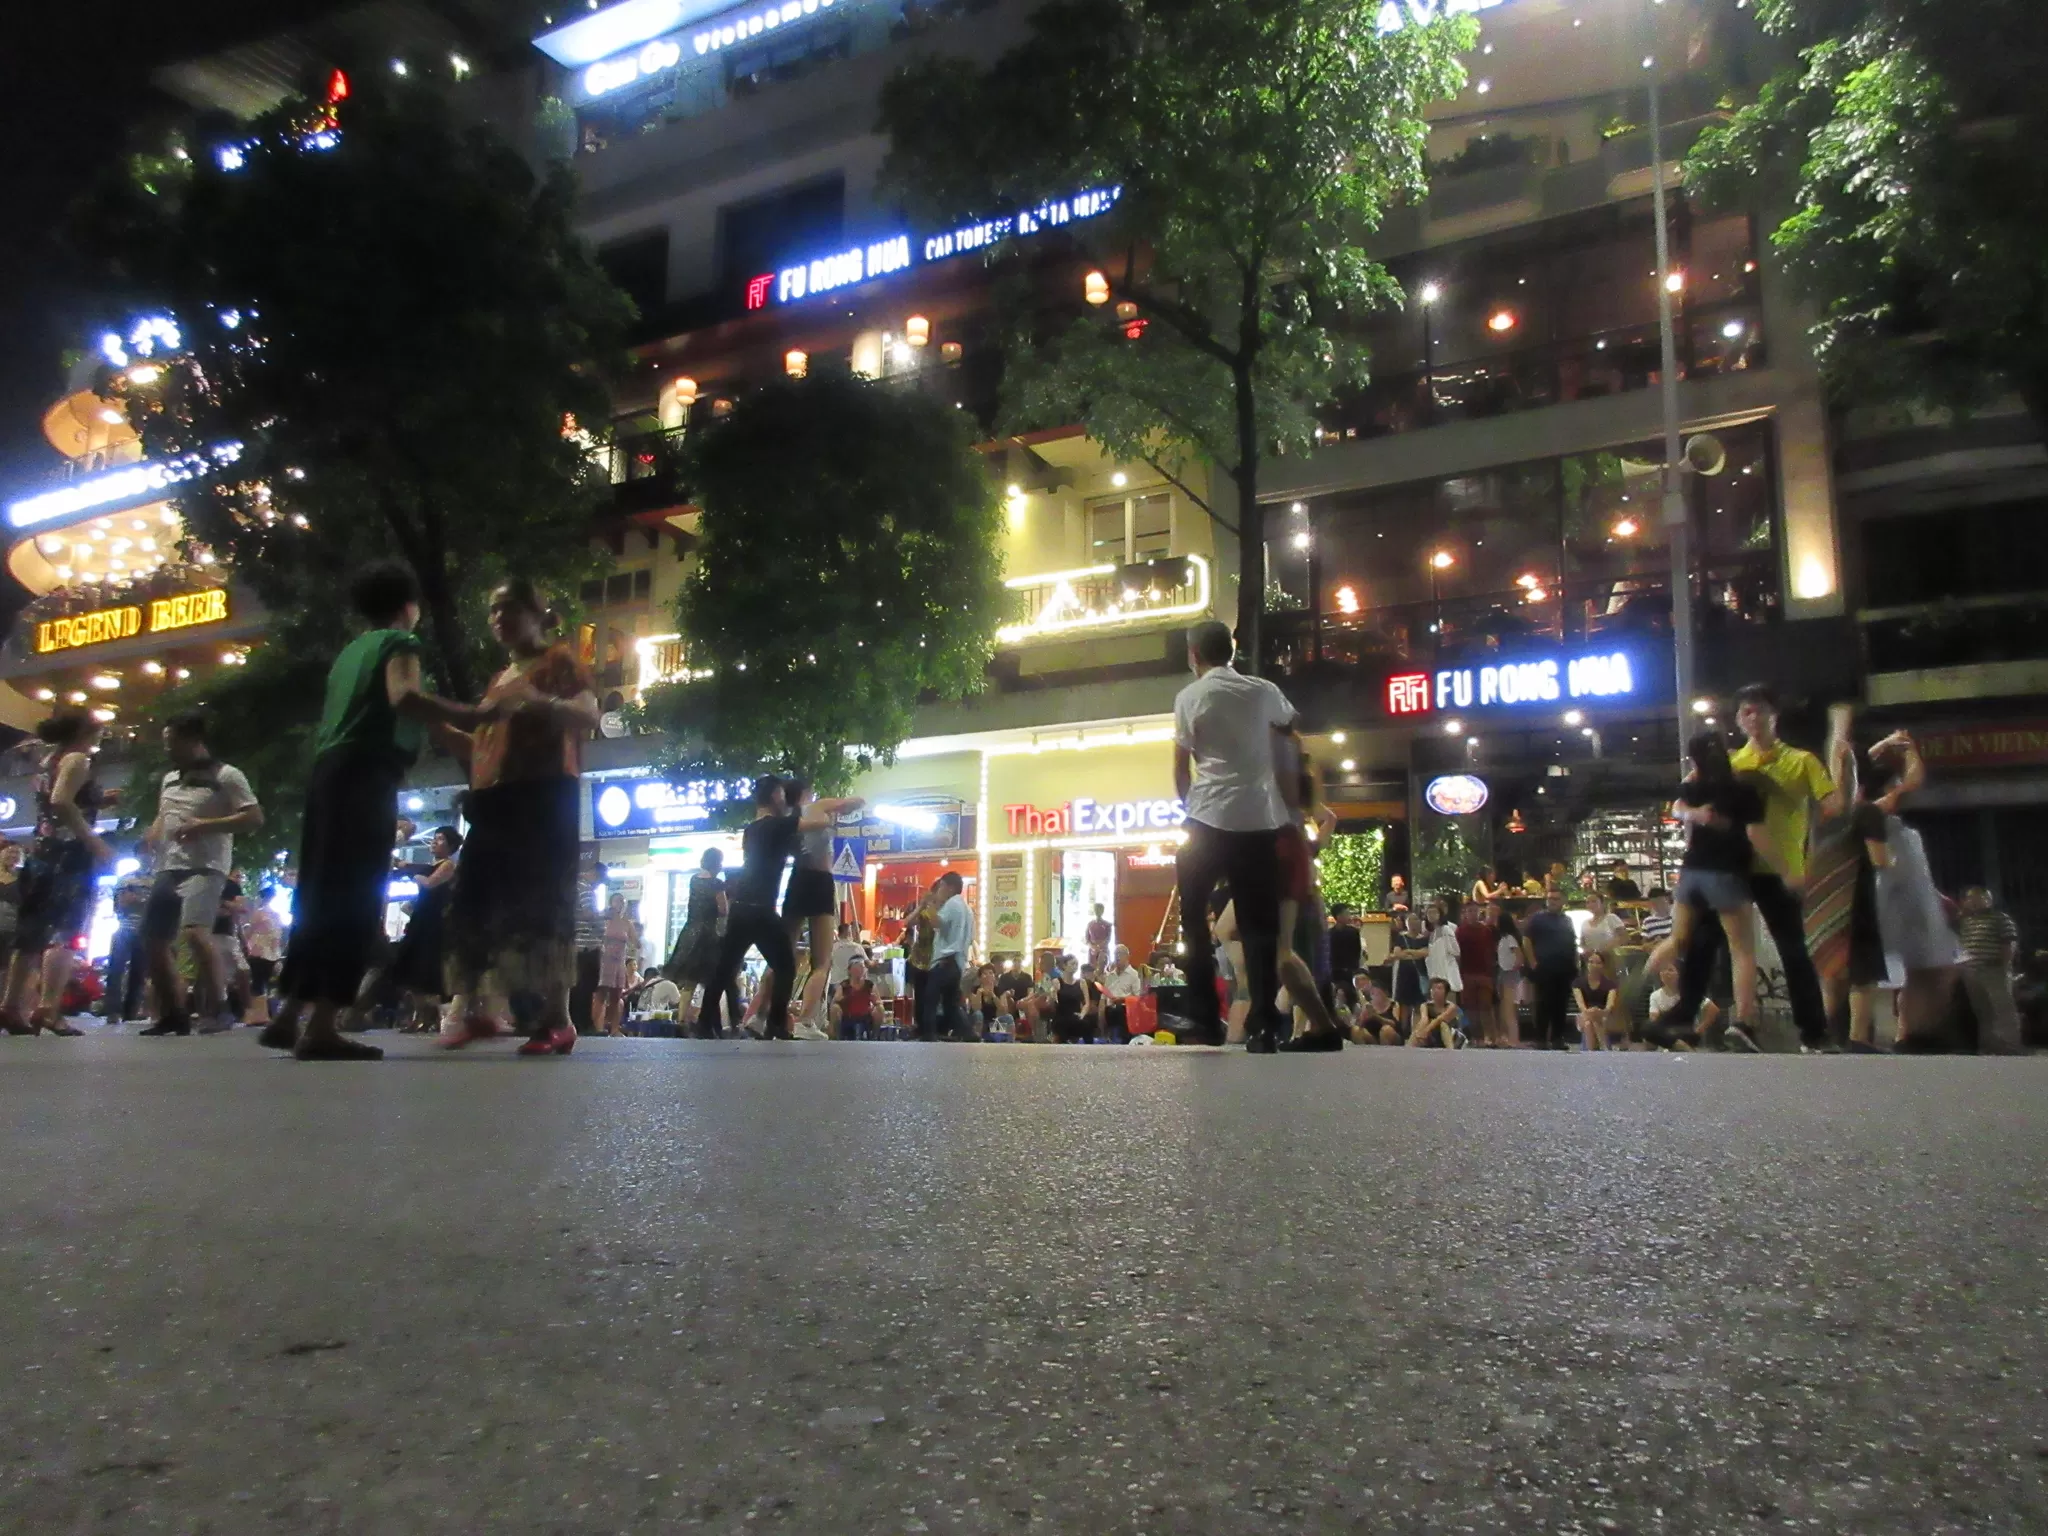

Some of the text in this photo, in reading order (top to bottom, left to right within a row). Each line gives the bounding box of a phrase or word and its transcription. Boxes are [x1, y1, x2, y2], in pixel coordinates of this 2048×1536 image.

[779, 264, 806, 302] FU
[810, 248, 863, 294] RONG
[38, 589, 227, 653] LEGEND BEER
[1436, 669, 1472, 709] FU
[1480, 659, 1560, 706] RONG
[1004, 797, 1188, 836] ThaiExpres
